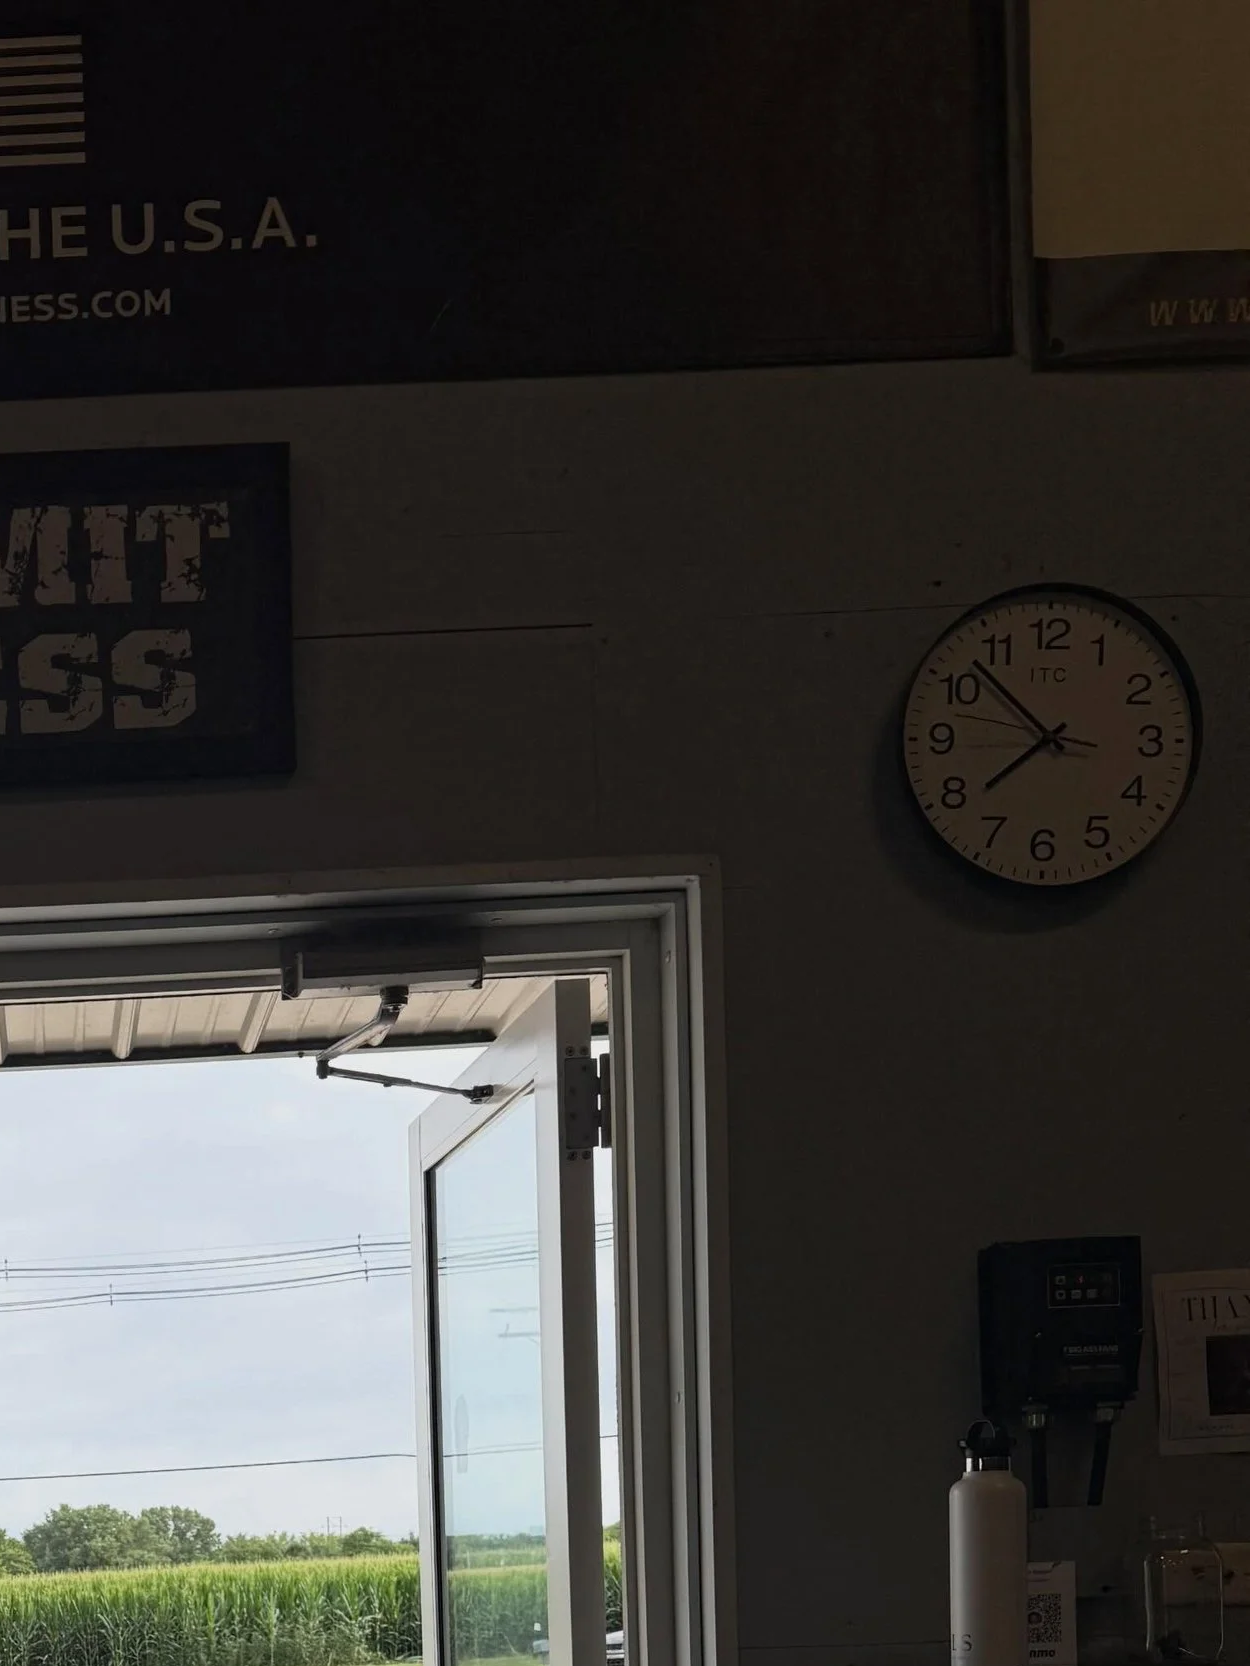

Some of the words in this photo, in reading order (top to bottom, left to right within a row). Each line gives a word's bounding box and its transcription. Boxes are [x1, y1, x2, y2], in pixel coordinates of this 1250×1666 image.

[110, 195, 319, 255] U.S.A.
[981, 633, 1012, 666] 11
[1028, 617, 1072, 651] 12
[1090, 633, 1106, 666] 1
[940, 671, 981, 705] 10
[1030, 666, 1068, 683] ITC
[1125, 673, 1152, 706] 2
[929, 722, 956, 755] 9
[1137, 724, 1164, 758] 3
[940, 775, 967, 810] 8
[1120, 774, 1148, 807] 4
[980, 816, 1008, 849] 7
[1029, 828, 1056, 862] 6
[1083, 815, 1110, 849] 5
